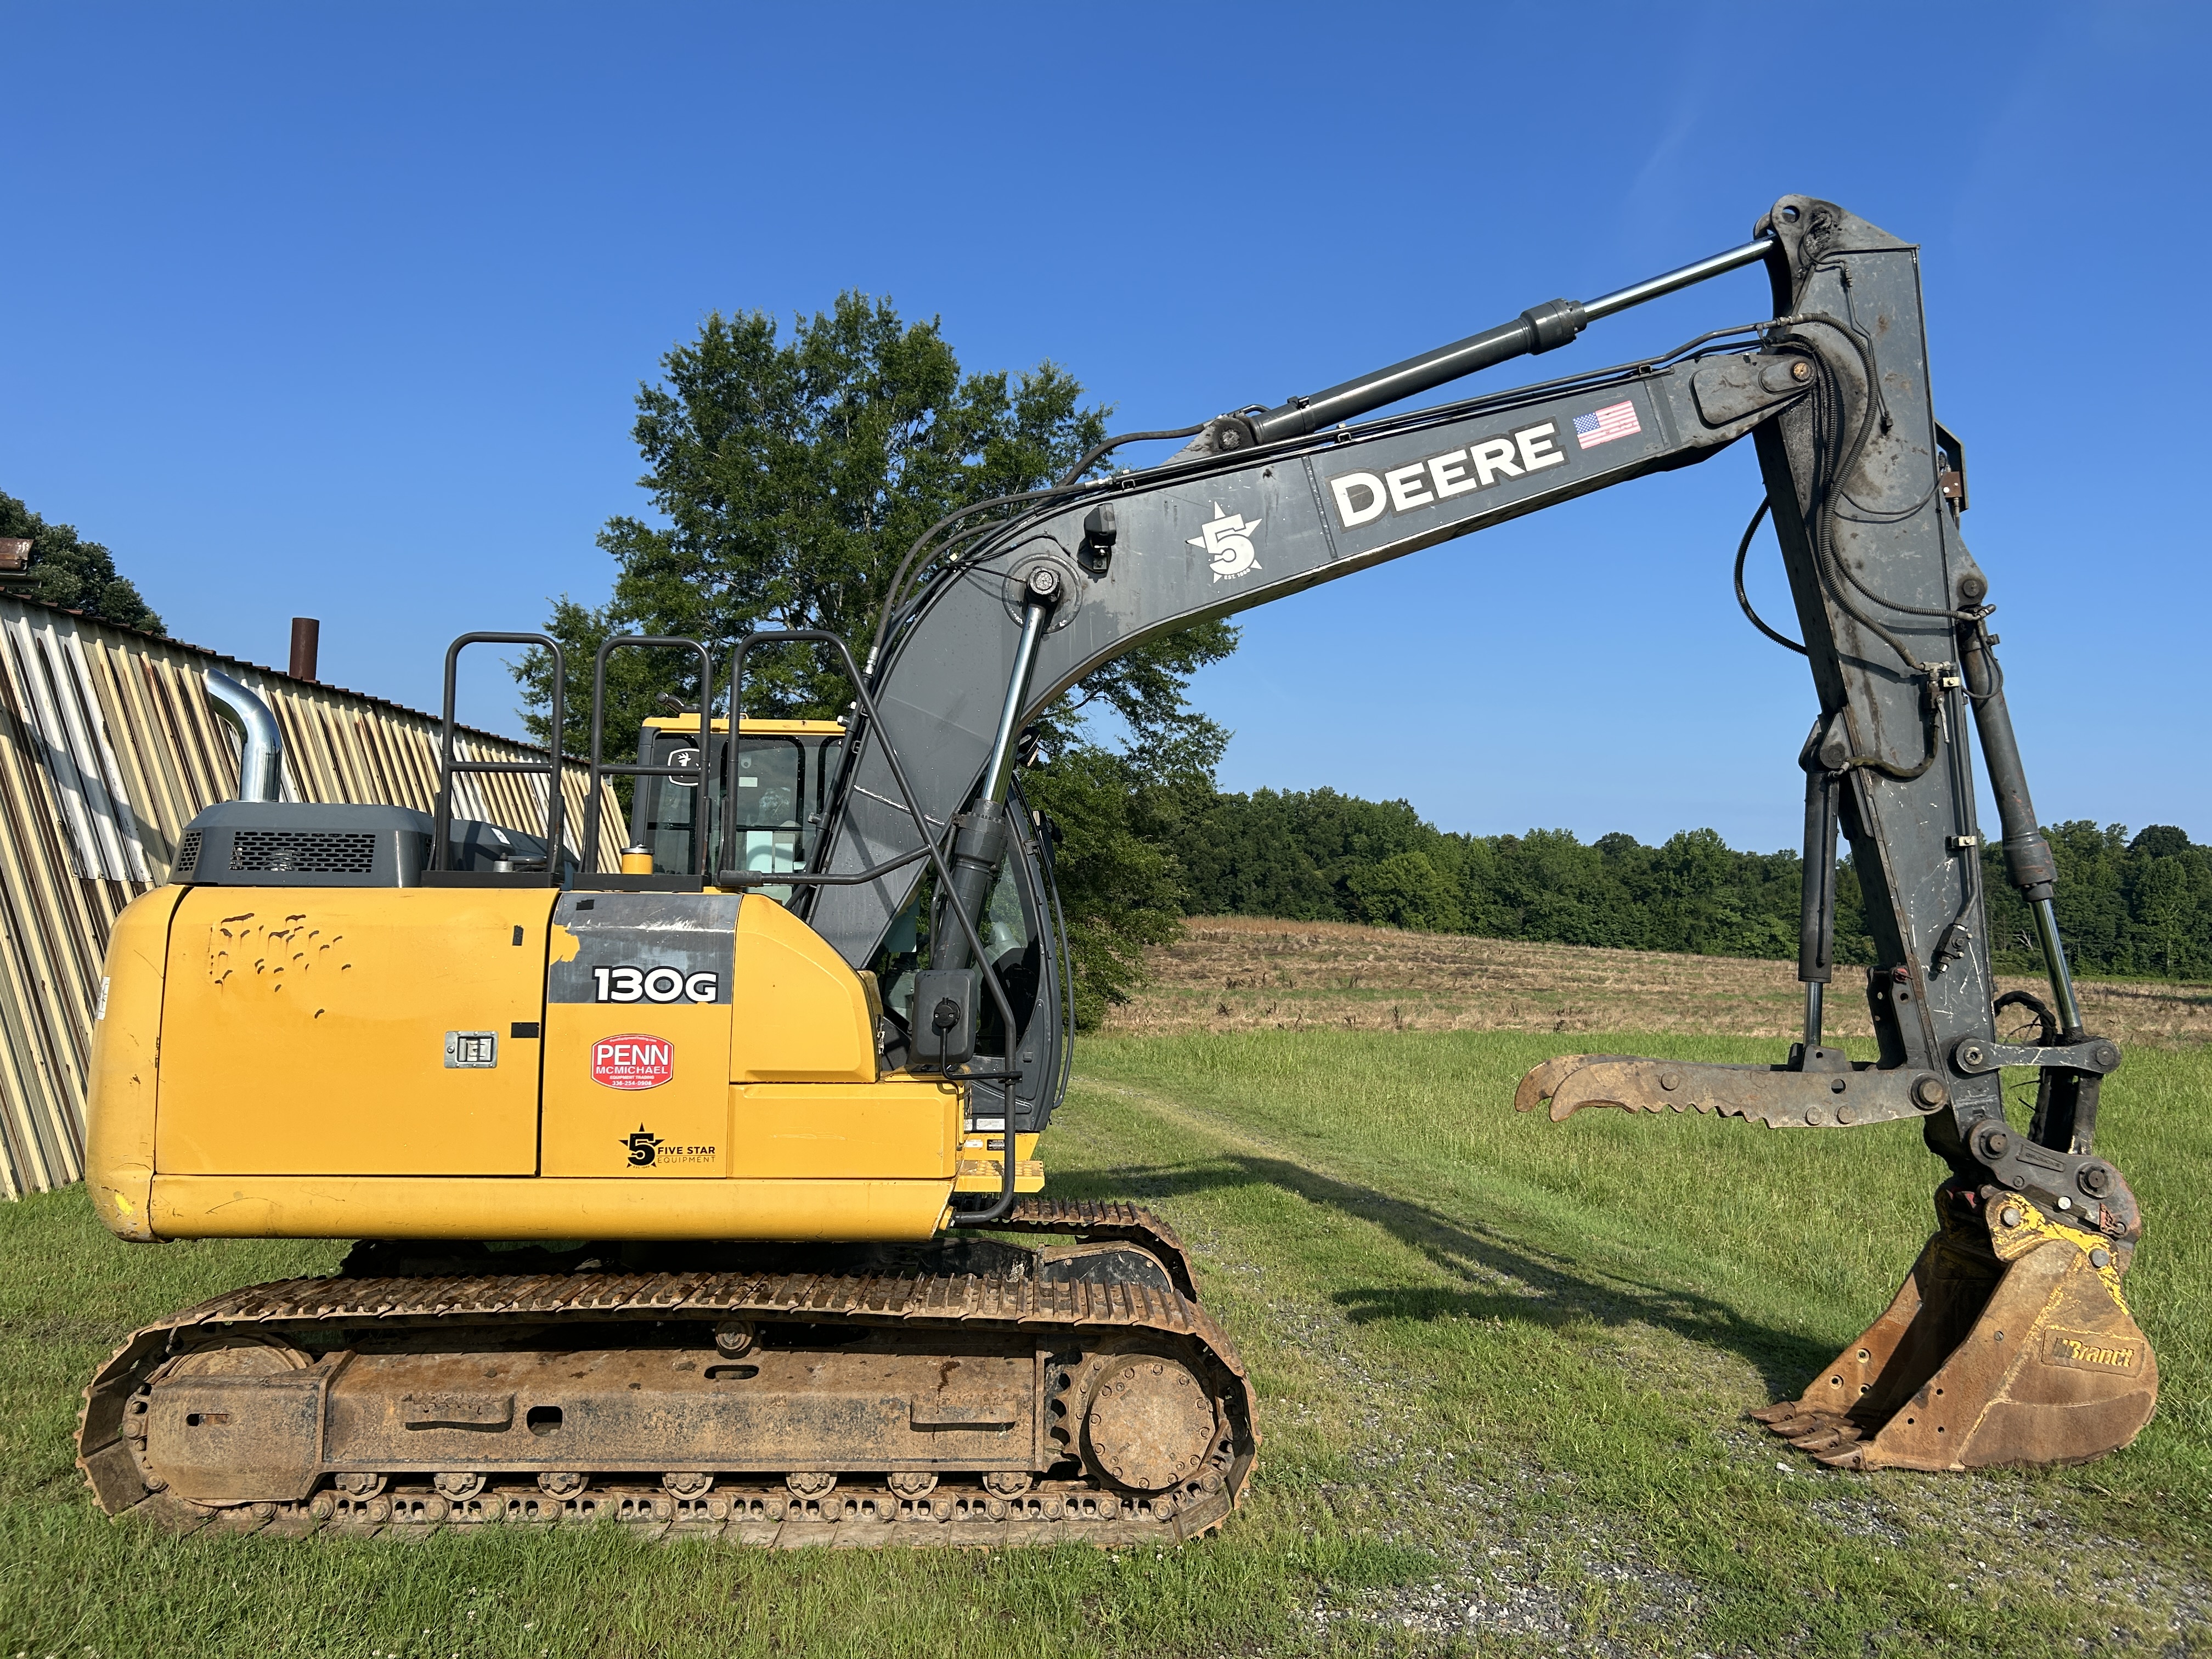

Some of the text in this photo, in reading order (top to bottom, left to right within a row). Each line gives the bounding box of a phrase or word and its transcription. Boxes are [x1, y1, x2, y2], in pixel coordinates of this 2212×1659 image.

[1330, 422, 1564, 527] DEERE
[1201, 514, 1254, 575] 5
[593, 967, 718, 1003] 130G
[596, 1066, 668, 1074] MCMICHAEL
[597, 1044, 669, 1065] PENN
[627, 1133, 656, 1166] 5
[658, 1146, 715, 1155] FIVE STAR
